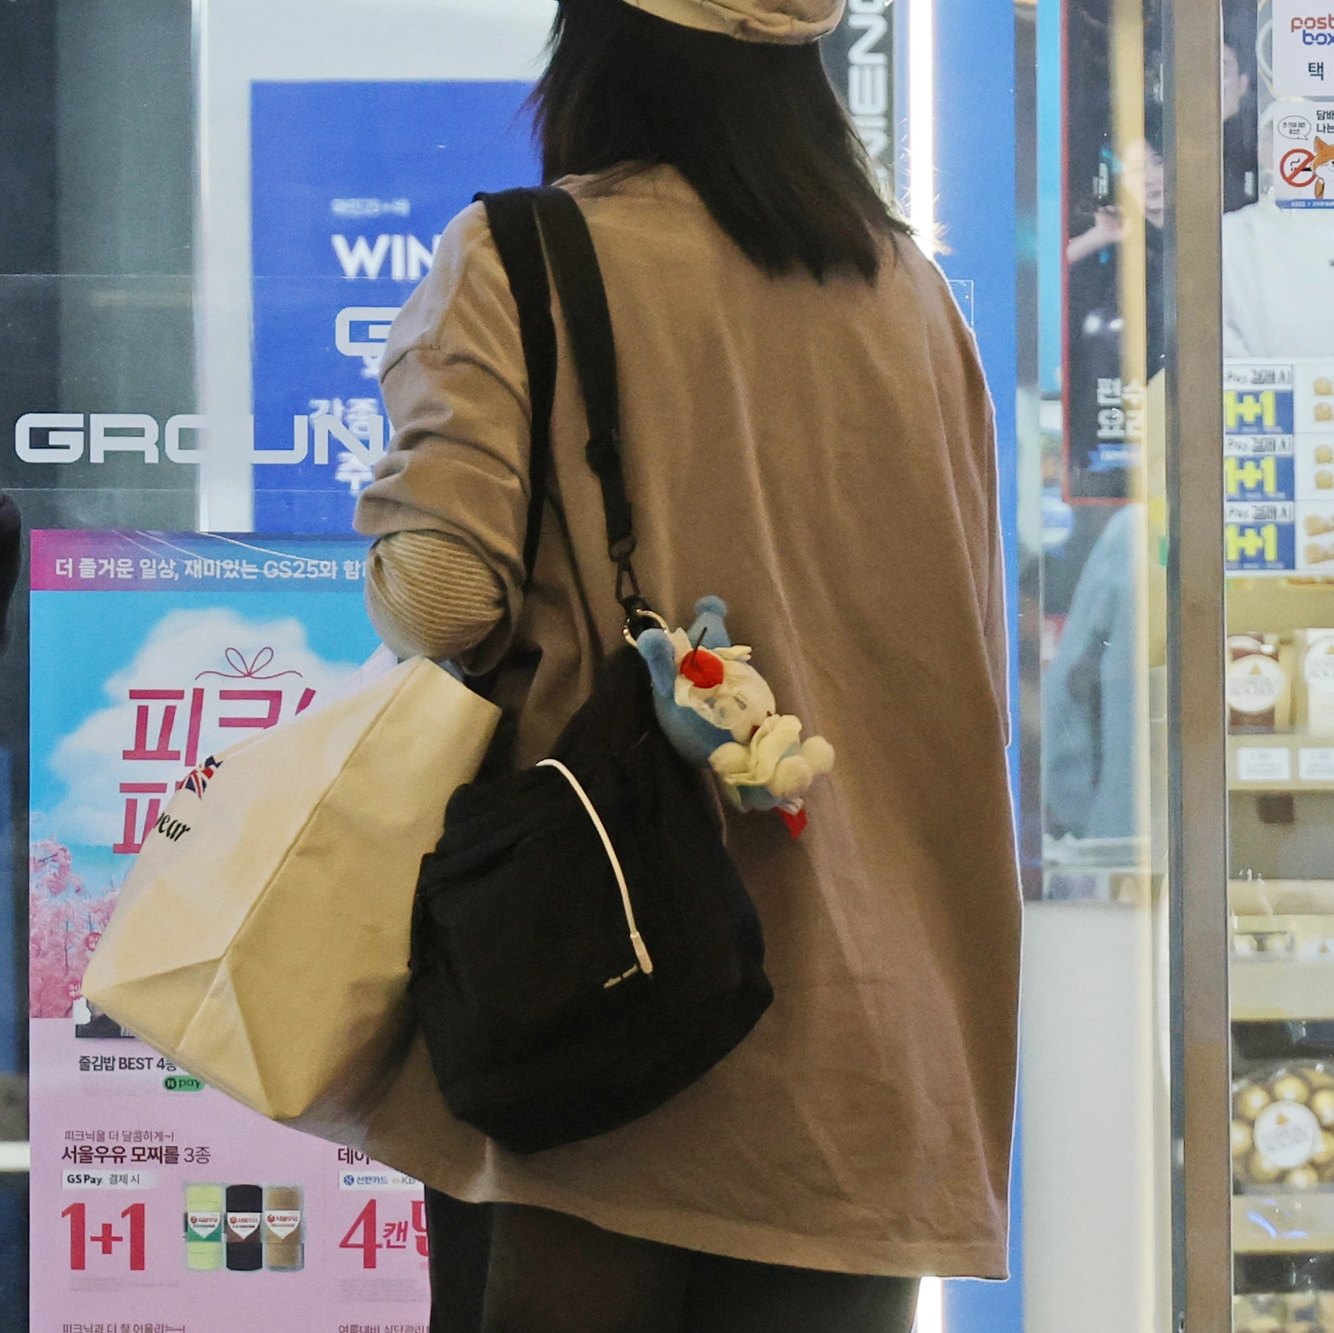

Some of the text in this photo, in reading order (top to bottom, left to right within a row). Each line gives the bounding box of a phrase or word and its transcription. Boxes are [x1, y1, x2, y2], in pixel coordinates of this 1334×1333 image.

[1291, 14, 1334, 33] post
[15, 413, 395, 465] GROUN
[55, 559, 73, 579] 더
[80, 559, 134, 579] 즐거운
[140, 559, 179, 582] 일상,
[186, 559, 257, 580] 재미있는
[264, 559, 338, 580] GS25와
[118, 1057, 153, 1070] BEST
[108, 1130, 119, 1143] 더
[62, 1145, 127, 1165] 서울우유
[183, 1146, 211, 1164] 3종
[109, 1174, 128, 1185] 결제
[130, 1174, 140, 1185] 시
[61, 1202, 146, 1272] 1+1
